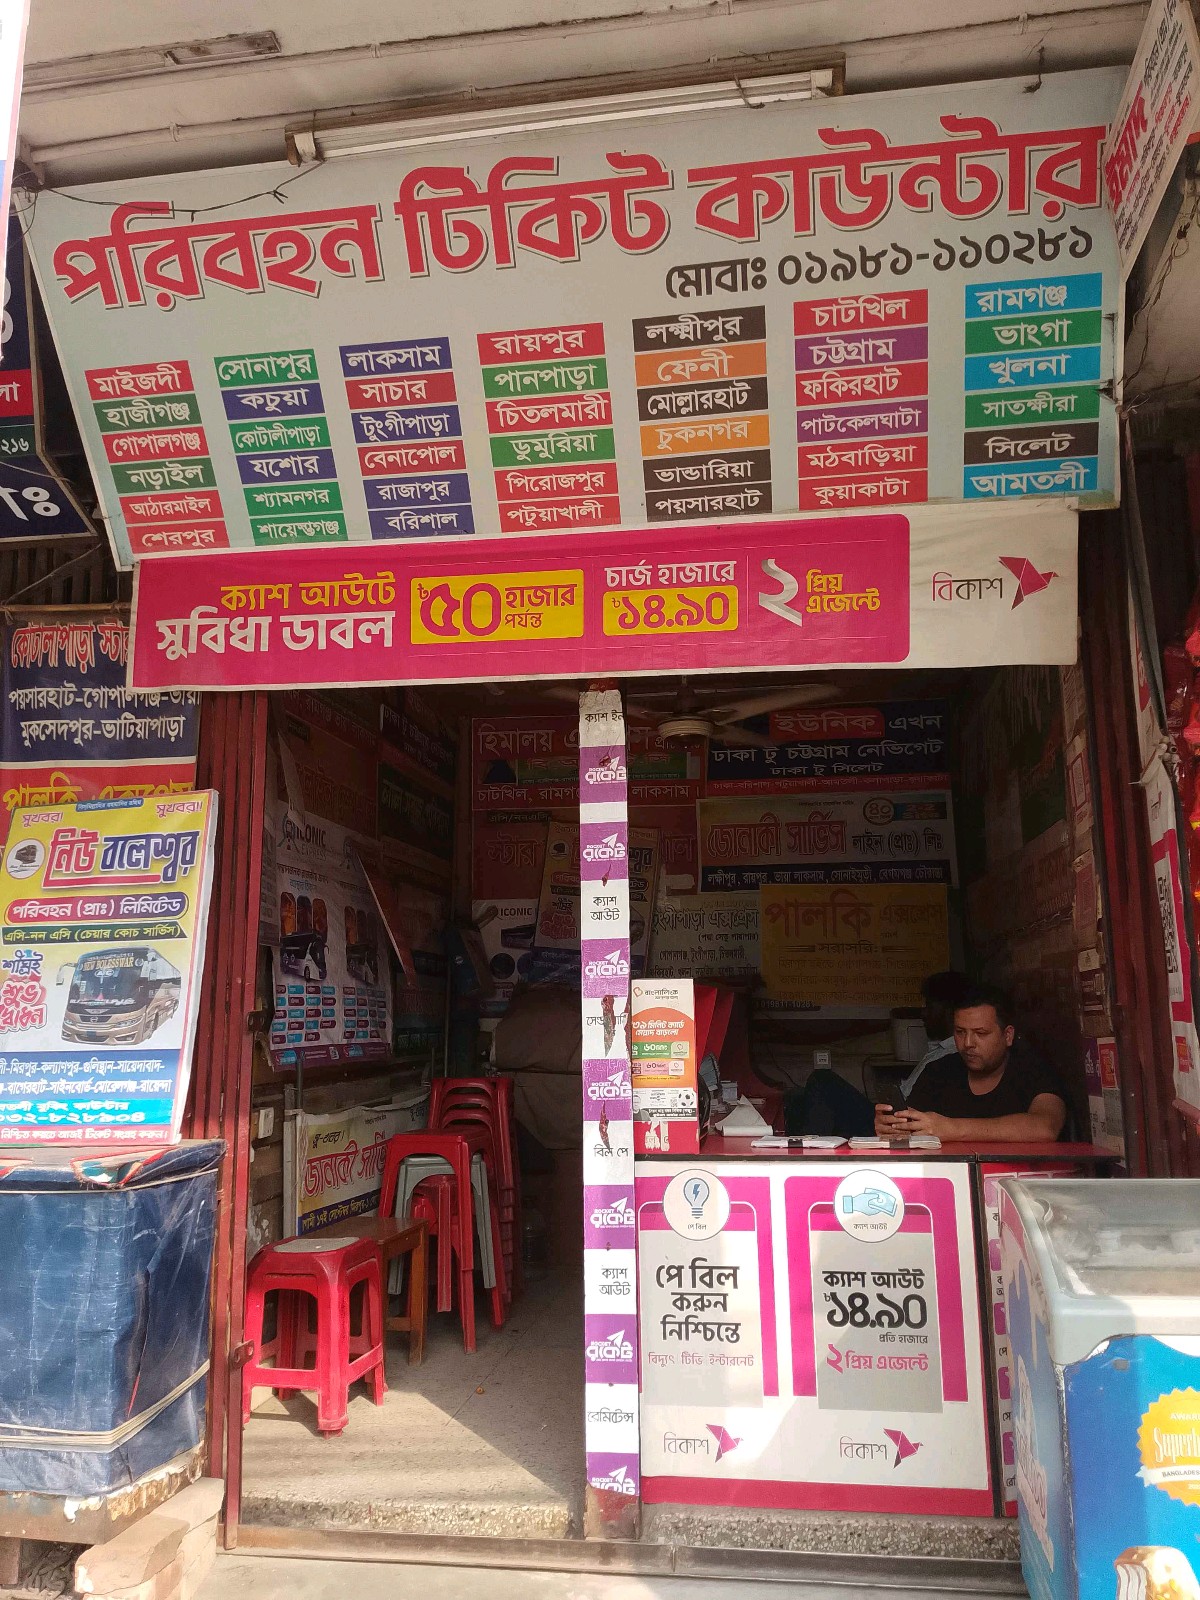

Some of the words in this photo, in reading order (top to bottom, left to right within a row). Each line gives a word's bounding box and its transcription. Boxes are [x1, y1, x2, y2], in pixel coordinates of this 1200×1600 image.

[53, 201, 386, 311] পরিবহন
[394, 149, 673, 278] টিকিট
[688, 114, 1106, 243] কাউন্টার
[666, 257, 767, 299] মোবাঃ
[778, 225, 1093, 285] ০১৯৮১-১১০২৮১
[811, 294, 911, 327] চাটখিল
[975, 284, 1069, 315] রামগঞ্জ
[491, 329, 586, 355] রায়পুর
[992, 318, 1073, 347] ভাংগা
[346, 345, 441, 372] লাকসাম
[657, 348, 734, 381] ফেনী
[809, 337, 897, 366] চট্টগ্রাম
[94, 364, 182, 396] মাইজদী
[218, 353, 312, 381] সোনাপুর
[494, 363, 597, 392] পানপাড়া
[988, 352, 1071, 384] খুলনা
[359, 379, 427, 403] সাচার
[800, 366, 902, 400] ফকিরহাট
[237, 388, 309, 412] কচুয়া
[495, 393, 609, 428] চিতলমারী
[648, 381, 752, 415] মোল্লারহাট
[982, 393, 1078, 421] সাতক্ষীরা
[102, 399, 191, 428] হাজীগঞ্জ
[360, 411, 450, 442] টুংগীপাড়া
[801, 408, 922, 435] পাটকেলঘাটা
[112, 430, 202, 457] গোপালগঞ্জ
[235, 423, 321, 449] কোটালীপাড়া
[509, 432, 597, 462] ডুমুরিয়া
[655, 420, 751, 451] চুকনগর
[983, 432, 1076, 459] সিলেট
[249, 455, 320, 477] যশোর
[364, 445, 456, 470] বেনাপোল
[806, 444, 917, 469] মঠবাড়িয়া
[126, 463, 203, 490] নড়াইল
[505, 470, 605, 494] পিরোজপুর
[970, 461, 1091, 495] আমতলী
[253, 488, 330, 508] শ্যামনগর
[376, 480, 451, 501] রাজাপুর
[655, 488, 763, 515] পয়সারহাট
[812, 478, 911, 506] কুয়াকাটা
[129, 495, 211, 517] আঠারমাইল
[507, 500, 604, 527] পটুয়াখালী
[385, 510, 459, 532] বরিশাল
[141, 529, 215, 548] শেরপুর
[605, 562, 652, 589] চার্জ
[656, 559, 737, 587] হাজারে
[806, 569, 843, 594] প্রিয়
[932, 571, 1004, 602] বিকাশ
[221, 583, 293, 612] ক্যাশ
[300, 571, 396, 610] আউটে
[505, 584, 577, 611] হাজার
[758, 558, 803, 628] ২
[805, 590, 881, 614] এজেন্টে
[156, 605, 271, 662] সুবিধা
[281, 610, 396, 651] ডাবল
[505, 611, 544, 630] পর্যন্ত
[585, 711, 609, 724] ক্যাশ
[774, 710, 876, 735] ইউনিক
[888, 713, 943, 731] এখন
[711, 747, 757, 763] ঢাকা
[762, 745, 780, 766] টু
[857, 738, 945, 758] নেভিগেট
[769, 765, 808, 776] ঢাকা
[831, 761, 885, 775] সিলেট
[632, 783, 690, 799] লাকসাম
[99, 831, 200, 884] বলেশ্বর
[582, 841, 626, 862] রকেট
[13, 900, 72, 919] পরিবহন
[77, 901, 115, 917] (প্রাঃ)
[120, 896, 183, 915] লিমিটেড
[500, 907, 533, 917] ICONIC
[592, 894, 618, 907] ক্যাশ
[590, 908, 621, 921] আউট
[764, 888, 875, 940] পালকি
[4, 931, 46, 942] এসি-নন
[50, 928, 70, 941] এসি
[114, 928, 138, 938] কোচ
[584, 958, 630, 978] রকেট
[587, 1079, 632, 1100] রকেট
[616, 1148, 629, 1157] পে
[853, 1222, 867, 1230] ক্যাশ
[869, 1222, 888, 1230] আউট
[601, 1267, 628, 1280] ক্যাশ
[656, 1262, 684, 1290] পে
[689, 1257, 740, 1290] বিল
[822, 1270, 865, 1288] ক্যাশ
[872, 1268, 925, 1289] আউট
[598, 1283, 631, 1296] আউট
[672, 1292, 728, 1313] করুন
[660, 1315, 742, 1344] নিশ্চিন্তে
[878, 1332, 896, 1344] প্রতি
[897, 1333, 928, 1344] হাজারে
[585, 1340, 633, 1362] রকেট
[648, 1351, 675, 1367] বিদ্যুৎ
[681, 1351, 703, 1366] টিভি
[709, 1352, 755, 1367] ইন্টারনেট
[826, 1343, 843, 1373] ২
[845, 1350, 873, 1370] প্রিয়
[876, 1354, 929, 1371] এজেন্টে
[587, 1407, 634, 1424] রেমিটেন্স
[664, 1431, 710, 1455] বিকাশ
[839, 1435, 888, 1460] বিকাশ
